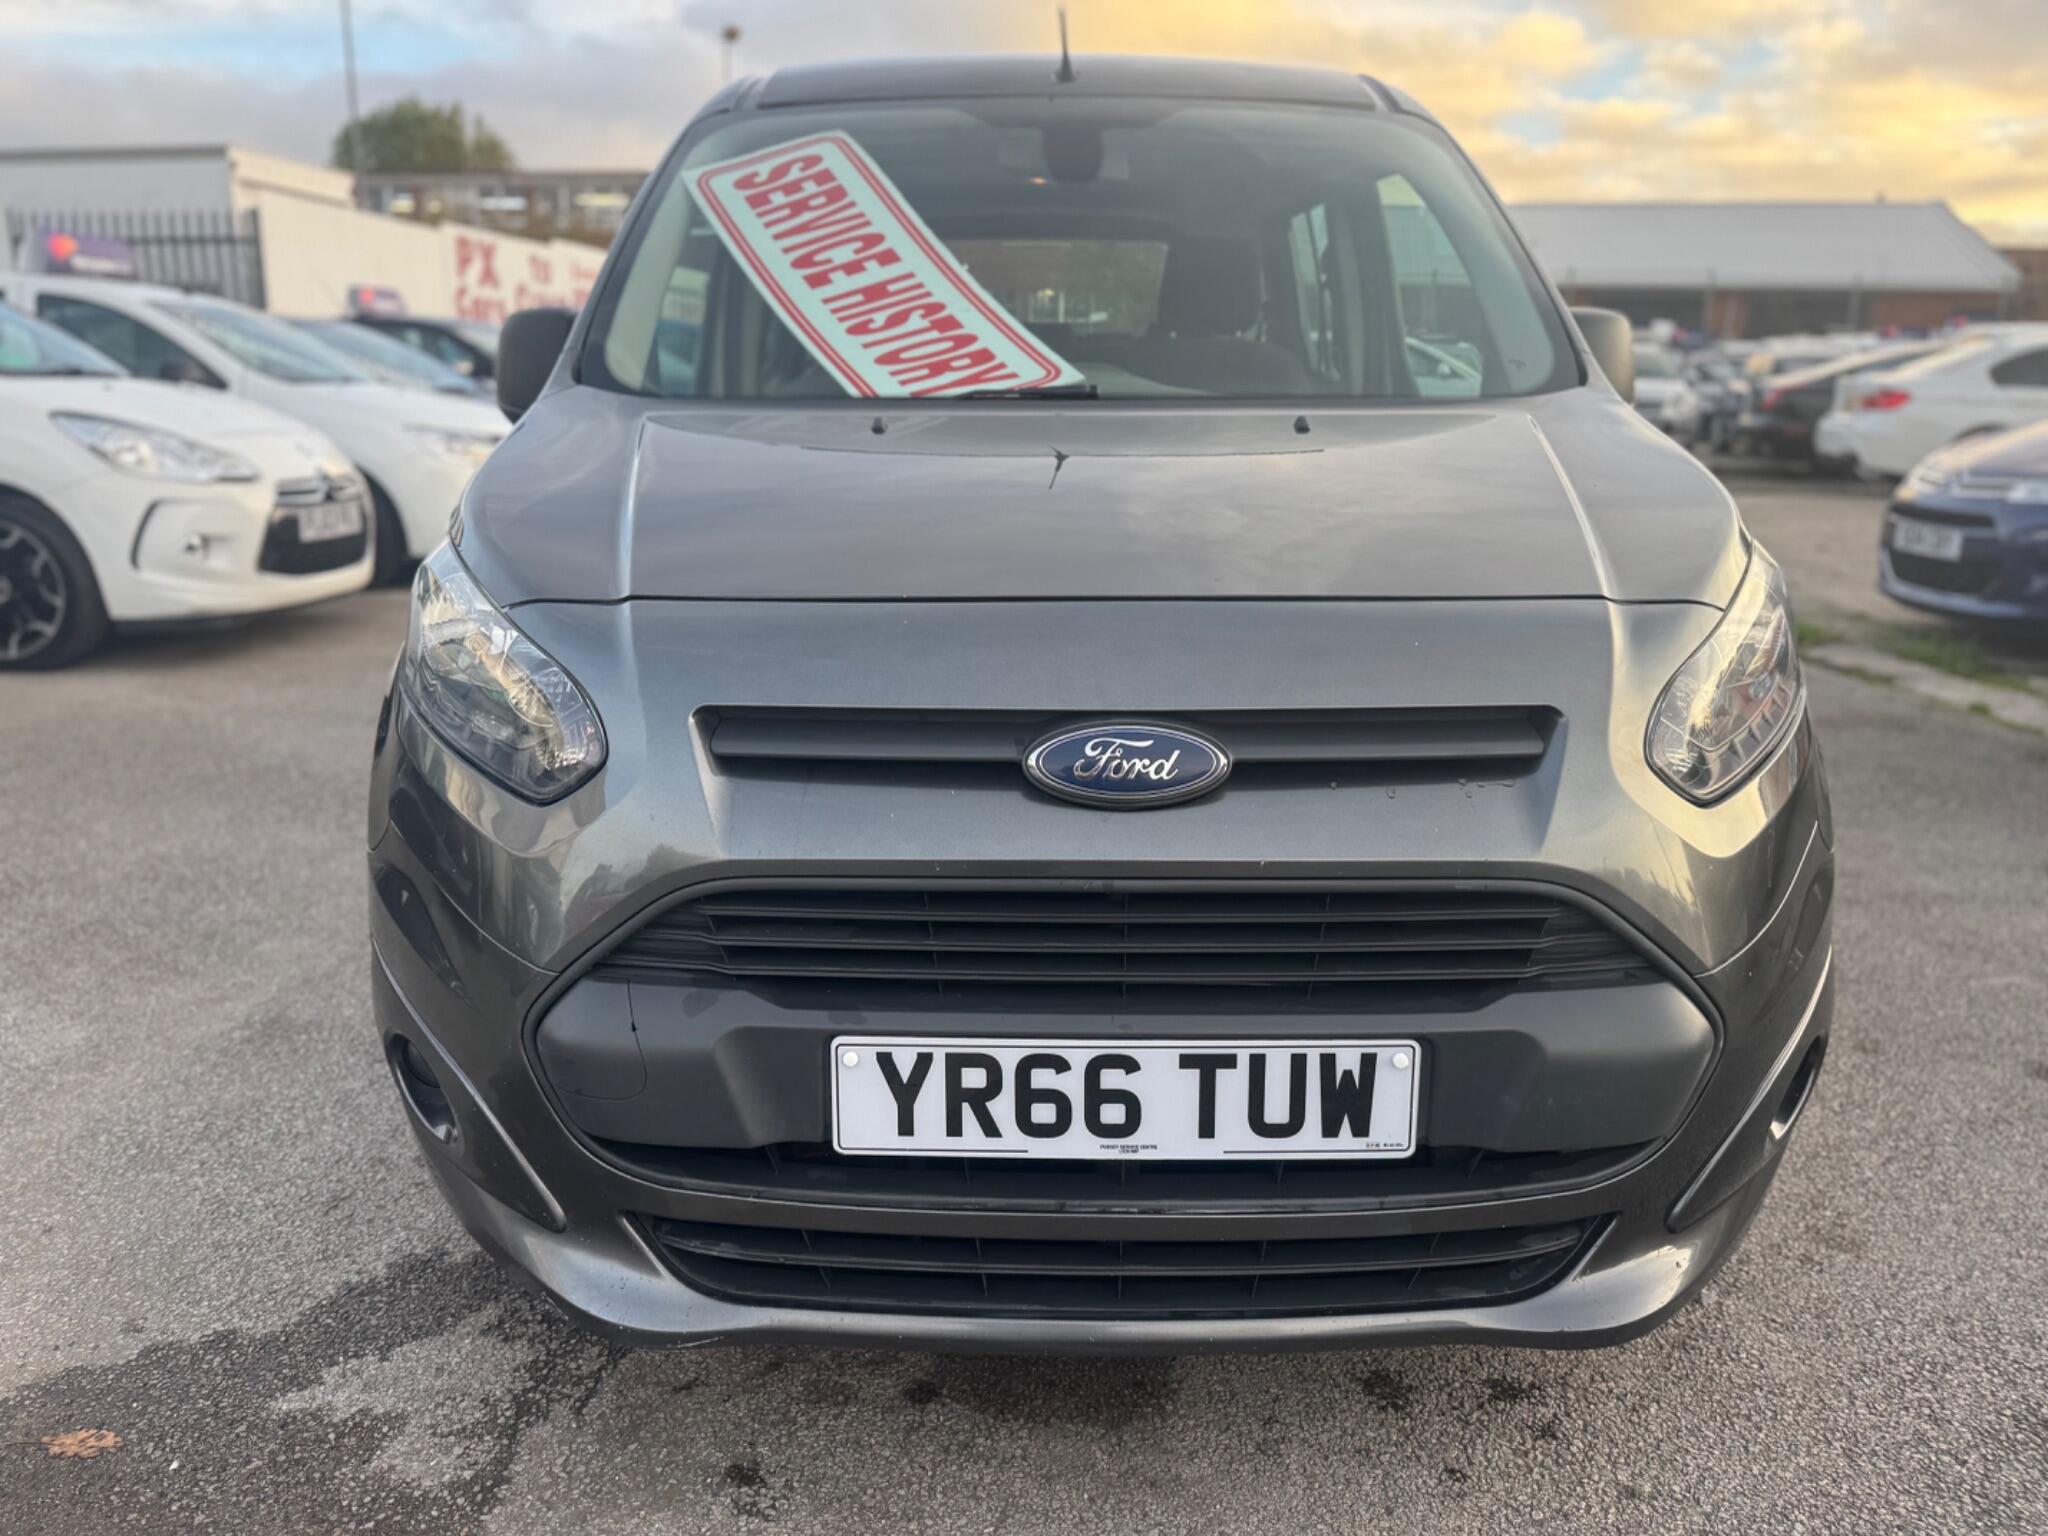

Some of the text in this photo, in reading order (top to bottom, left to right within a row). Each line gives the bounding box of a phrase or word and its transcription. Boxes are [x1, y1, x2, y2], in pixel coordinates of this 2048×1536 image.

[733, 154, 1021, 397] SERVICE HISTORY
[1073, 737, 1181, 781] Ford
[875, 1051, 1378, 1139] YR66 TUW
